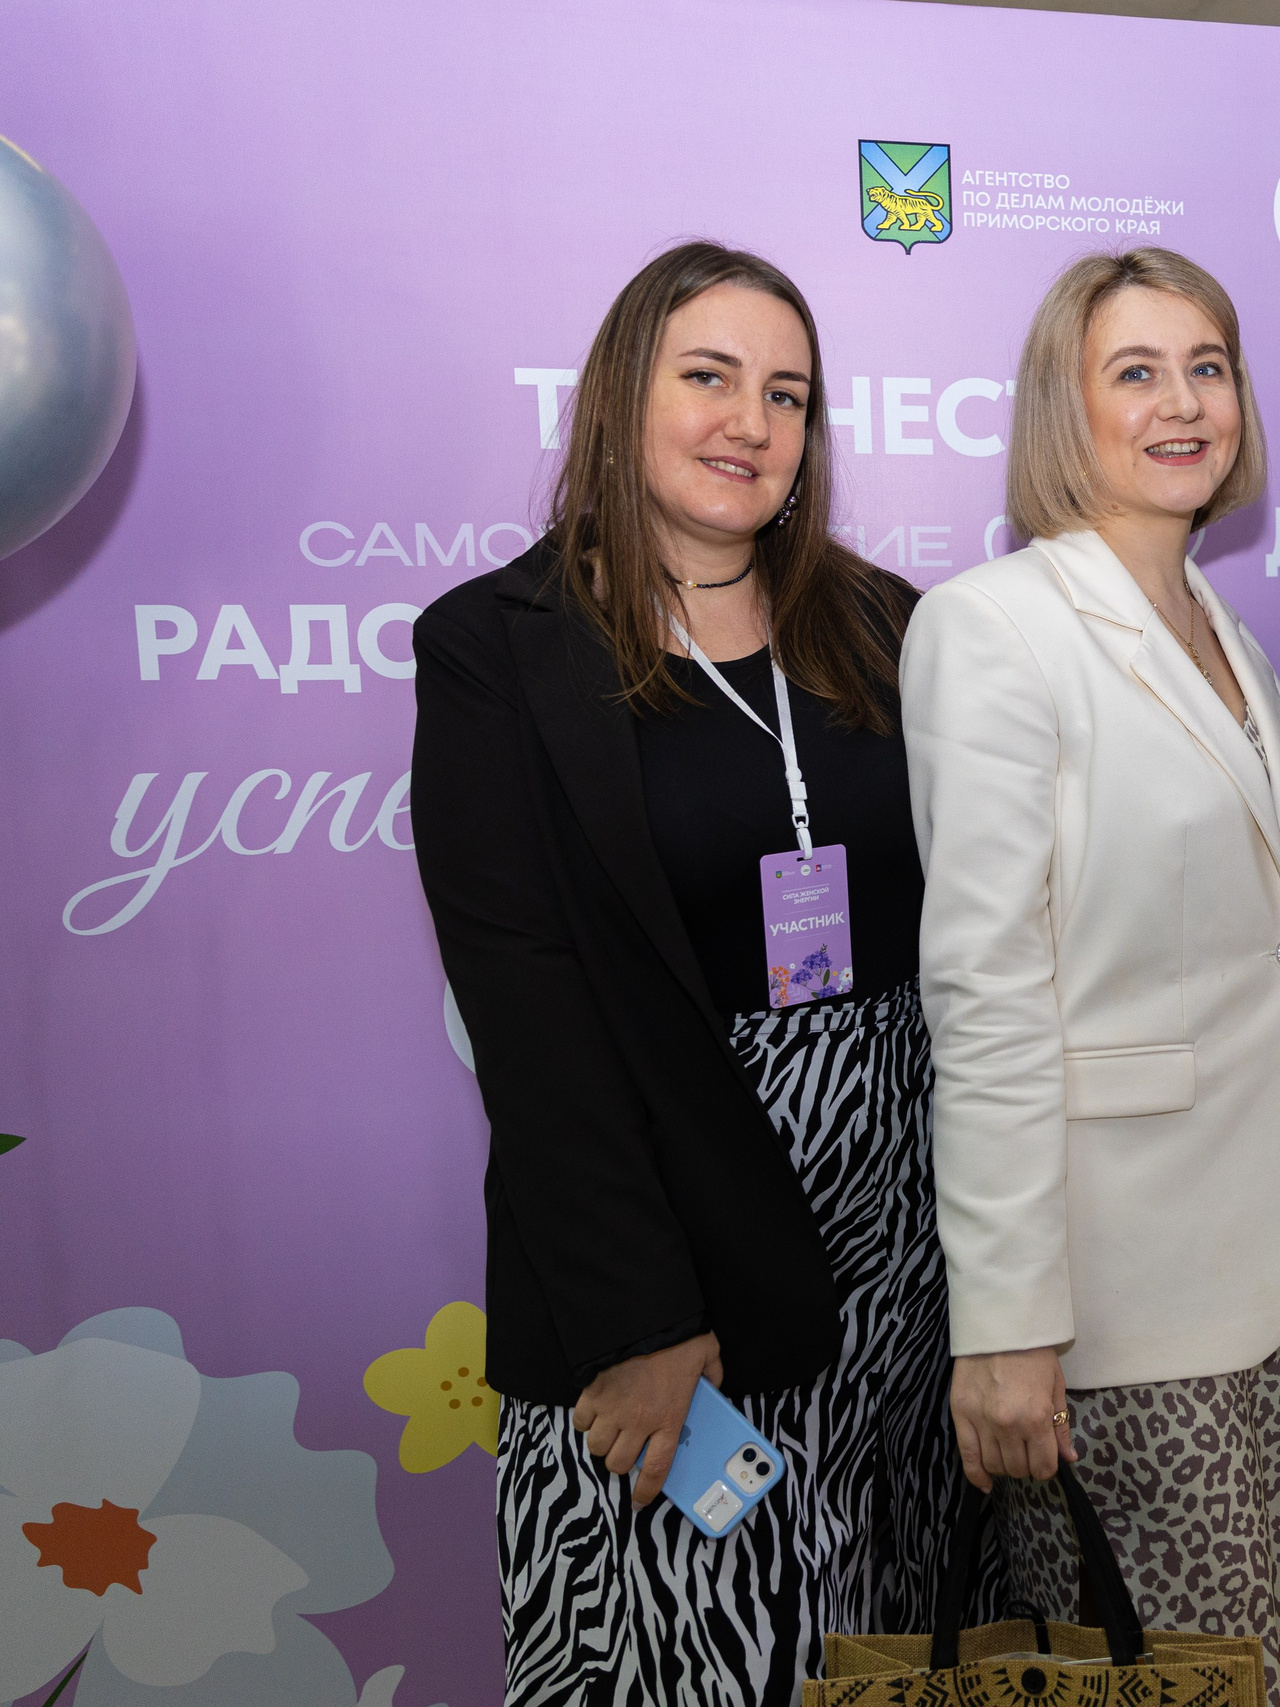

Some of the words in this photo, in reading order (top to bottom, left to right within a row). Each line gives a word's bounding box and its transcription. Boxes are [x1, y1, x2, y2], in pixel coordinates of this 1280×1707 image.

[961, 169, 1070, 190] АГЕНТСТВО
[962, 191, 991, 207] ПО
[995, 193, 1065, 211] ДЕЛАМ
[1070, 194, 1185, 216] МОЛОДЁЖИ
[963, 212, 1110, 233] ПРИМОРСКОГО
[1115, 217, 1161, 235] КРАЯ
[133, 602, 419, 694] РАДО
[62, 768, 416, 936] успе
[769, 911, 845, 937] УЧАСТНИК
